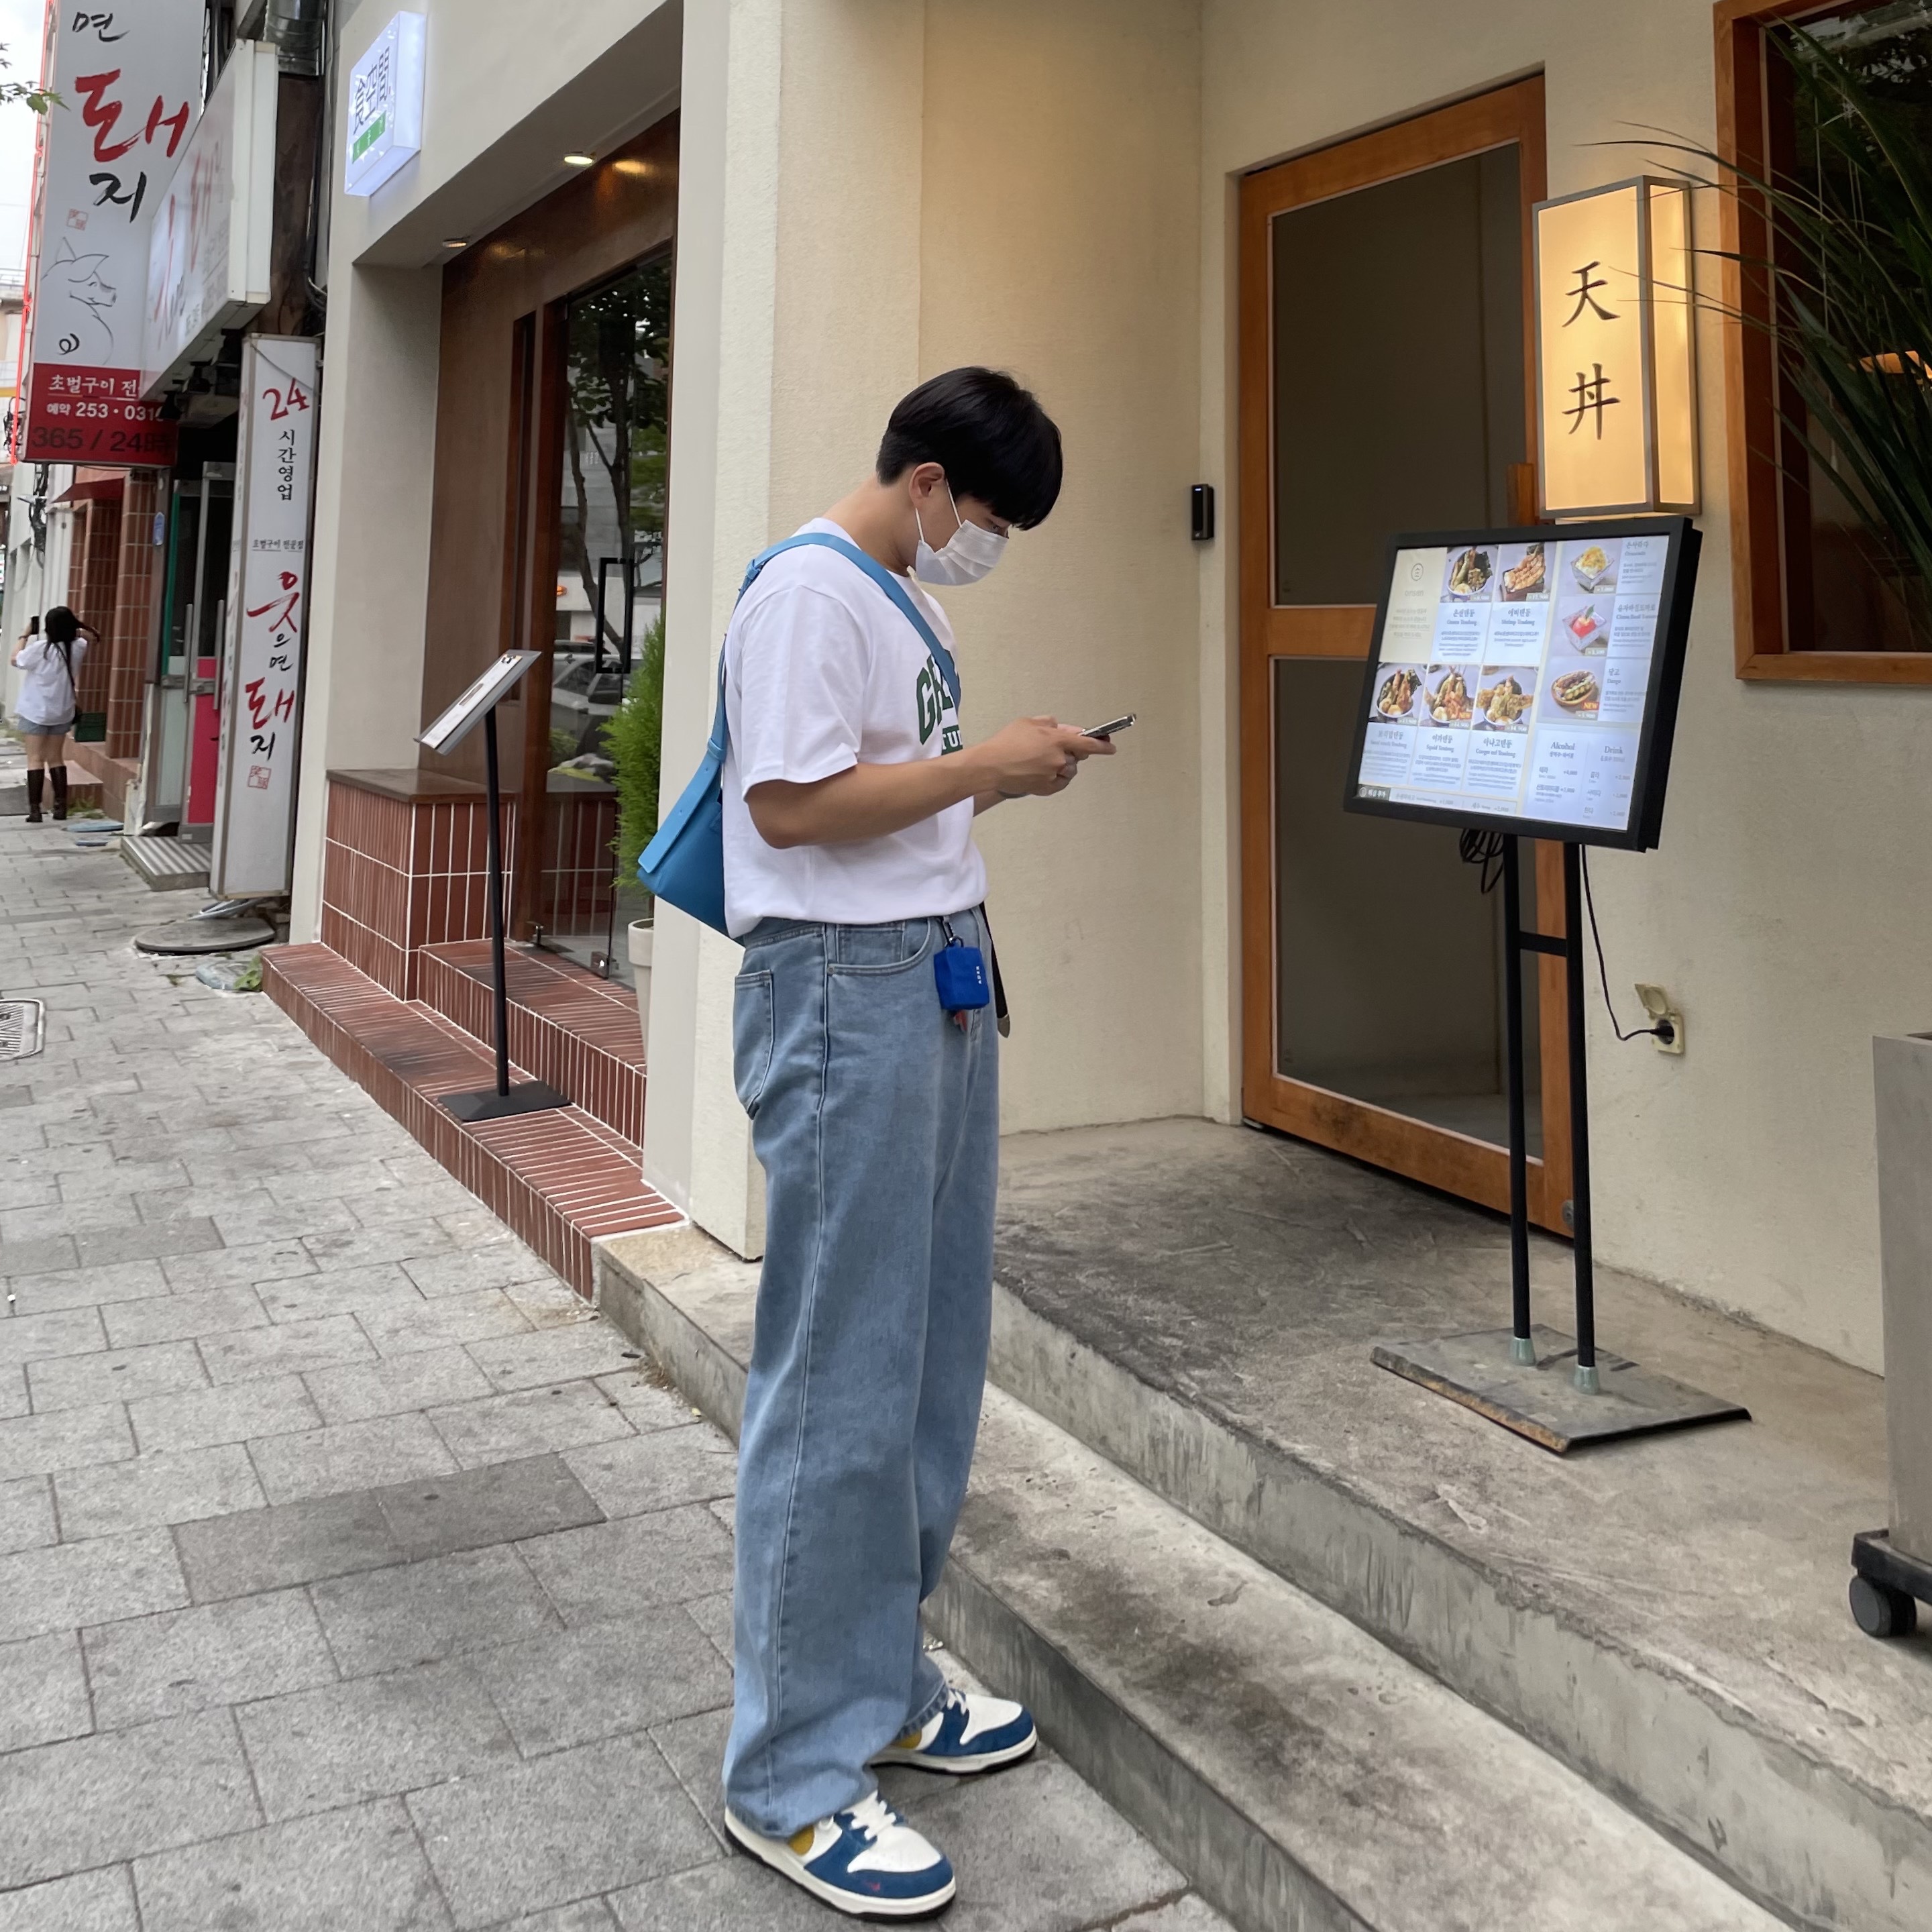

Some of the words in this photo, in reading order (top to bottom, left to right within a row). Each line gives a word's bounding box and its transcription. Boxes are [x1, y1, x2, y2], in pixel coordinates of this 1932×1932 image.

[72, 11, 130, 42] 면
[1562, 260, 1621, 441] 天丼
[48, 374, 115, 396] 초벌구이
[121, 379, 140, 397] 전
[262, 376, 310, 421] 24
[46, 402, 72, 416] 예약
[76, 402, 109, 419] 253
[32, 426, 84, 449] 365
[277, 429, 297, 501] 시간영업
[246, 571, 300, 672] 웃으면
[244, 677, 295, 761] 돼지
[1584, 702, 1598, 710] NEW
[1550, 741, 1575, 751] Alcohol
[1604, 745, 1623, 754] Drink
